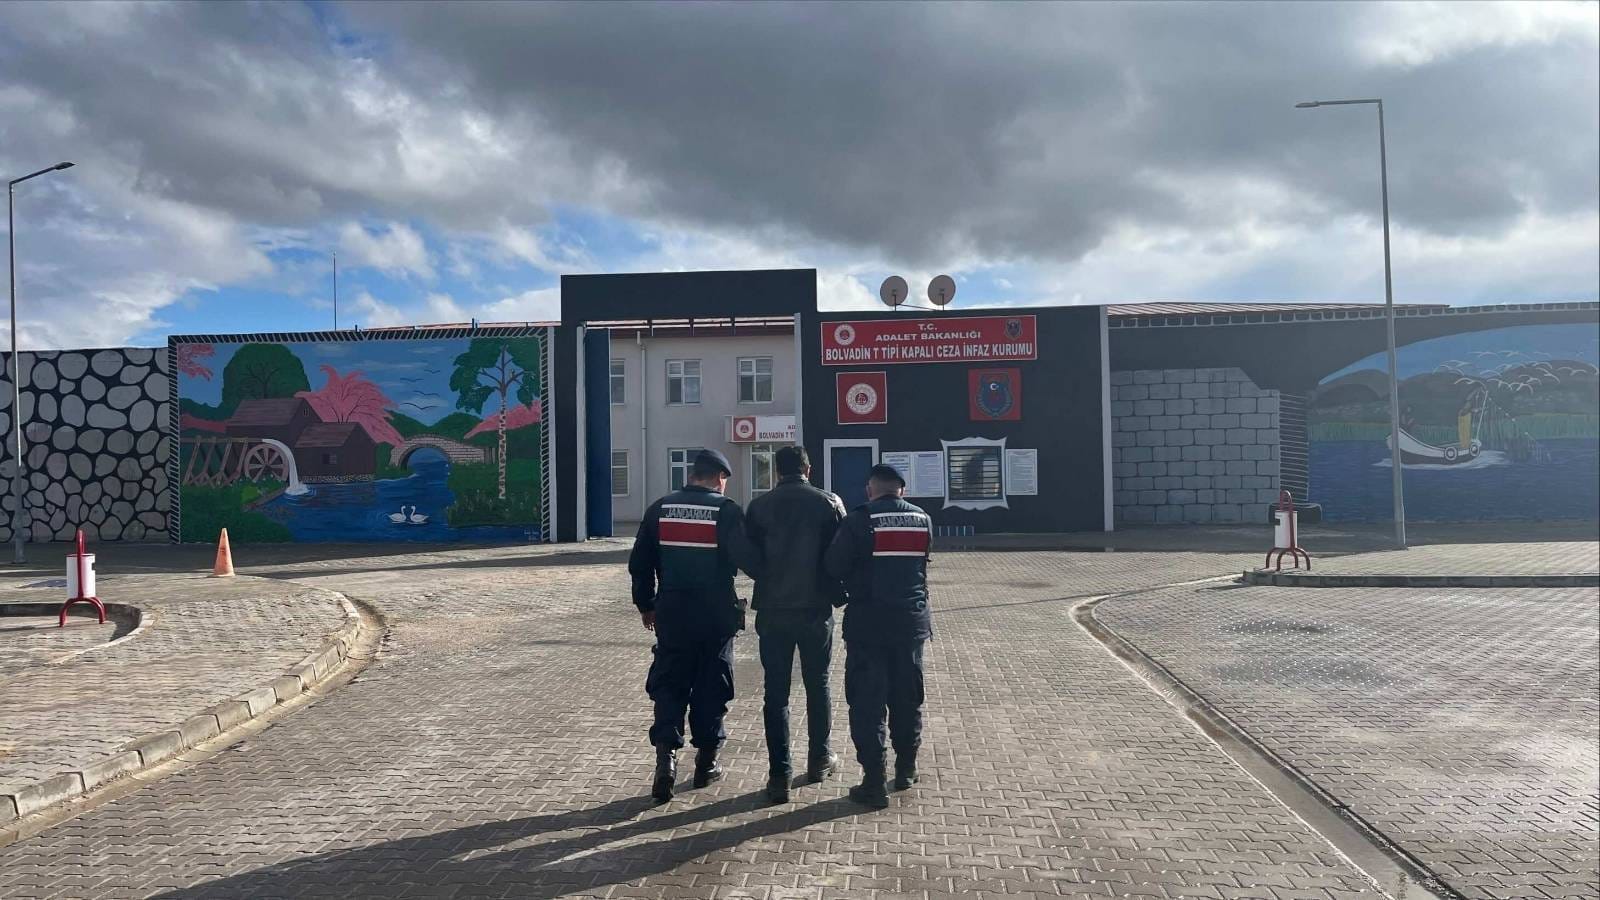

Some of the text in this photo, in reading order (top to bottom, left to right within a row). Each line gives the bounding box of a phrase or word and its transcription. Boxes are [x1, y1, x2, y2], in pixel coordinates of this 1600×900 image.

[917, 323, 938, 331] T.C.
[875, 331, 981, 342] ADALET BAKANLIĞI
[825, 342, 1033, 361] BOLVADİN T TİPİ KAPALI CEZA İNFAZ KURUMU
[665, 507, 713, 521] JANDARMA
[878, 515, 925, 527] JANDARMA
